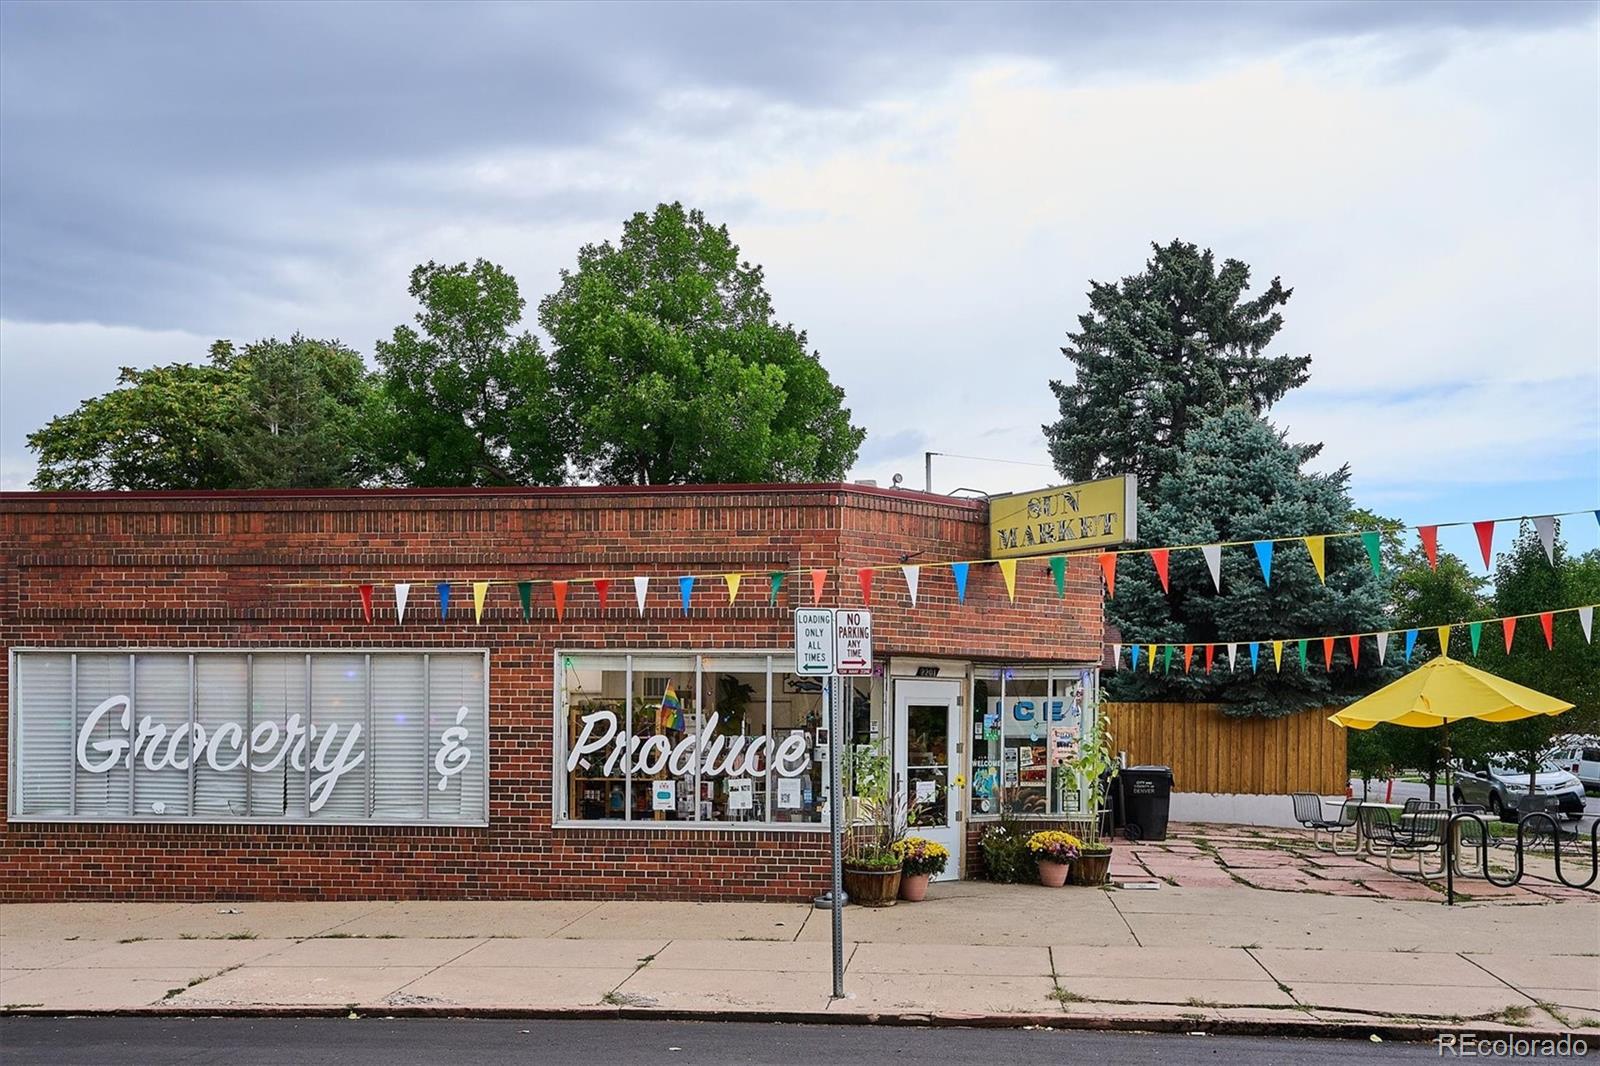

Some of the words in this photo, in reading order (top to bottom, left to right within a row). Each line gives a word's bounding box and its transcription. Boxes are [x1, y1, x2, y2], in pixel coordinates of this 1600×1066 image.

[1027, 490, 1082, 520] SUN
[997, 512, 1118, 550] MARKET
[798, 615, 830, 624] LOADING
[847, 613, 861, 626] NO
[805, 628, 824, 637] ONLY
[838, 626, 869, 639] PARKING
[808, 641, 821, 650] ALL
[847, 640, 861, 648] ANY
[804, 653, 826, 662] TIMES
[847, 649, 862, 658] TIME
[76, 694, 365, 813] Grocery
[434, 705, 471, 791] &
[567, 710, 810, 777] Produce
[972, 759, 1001, 768] WELCOME
